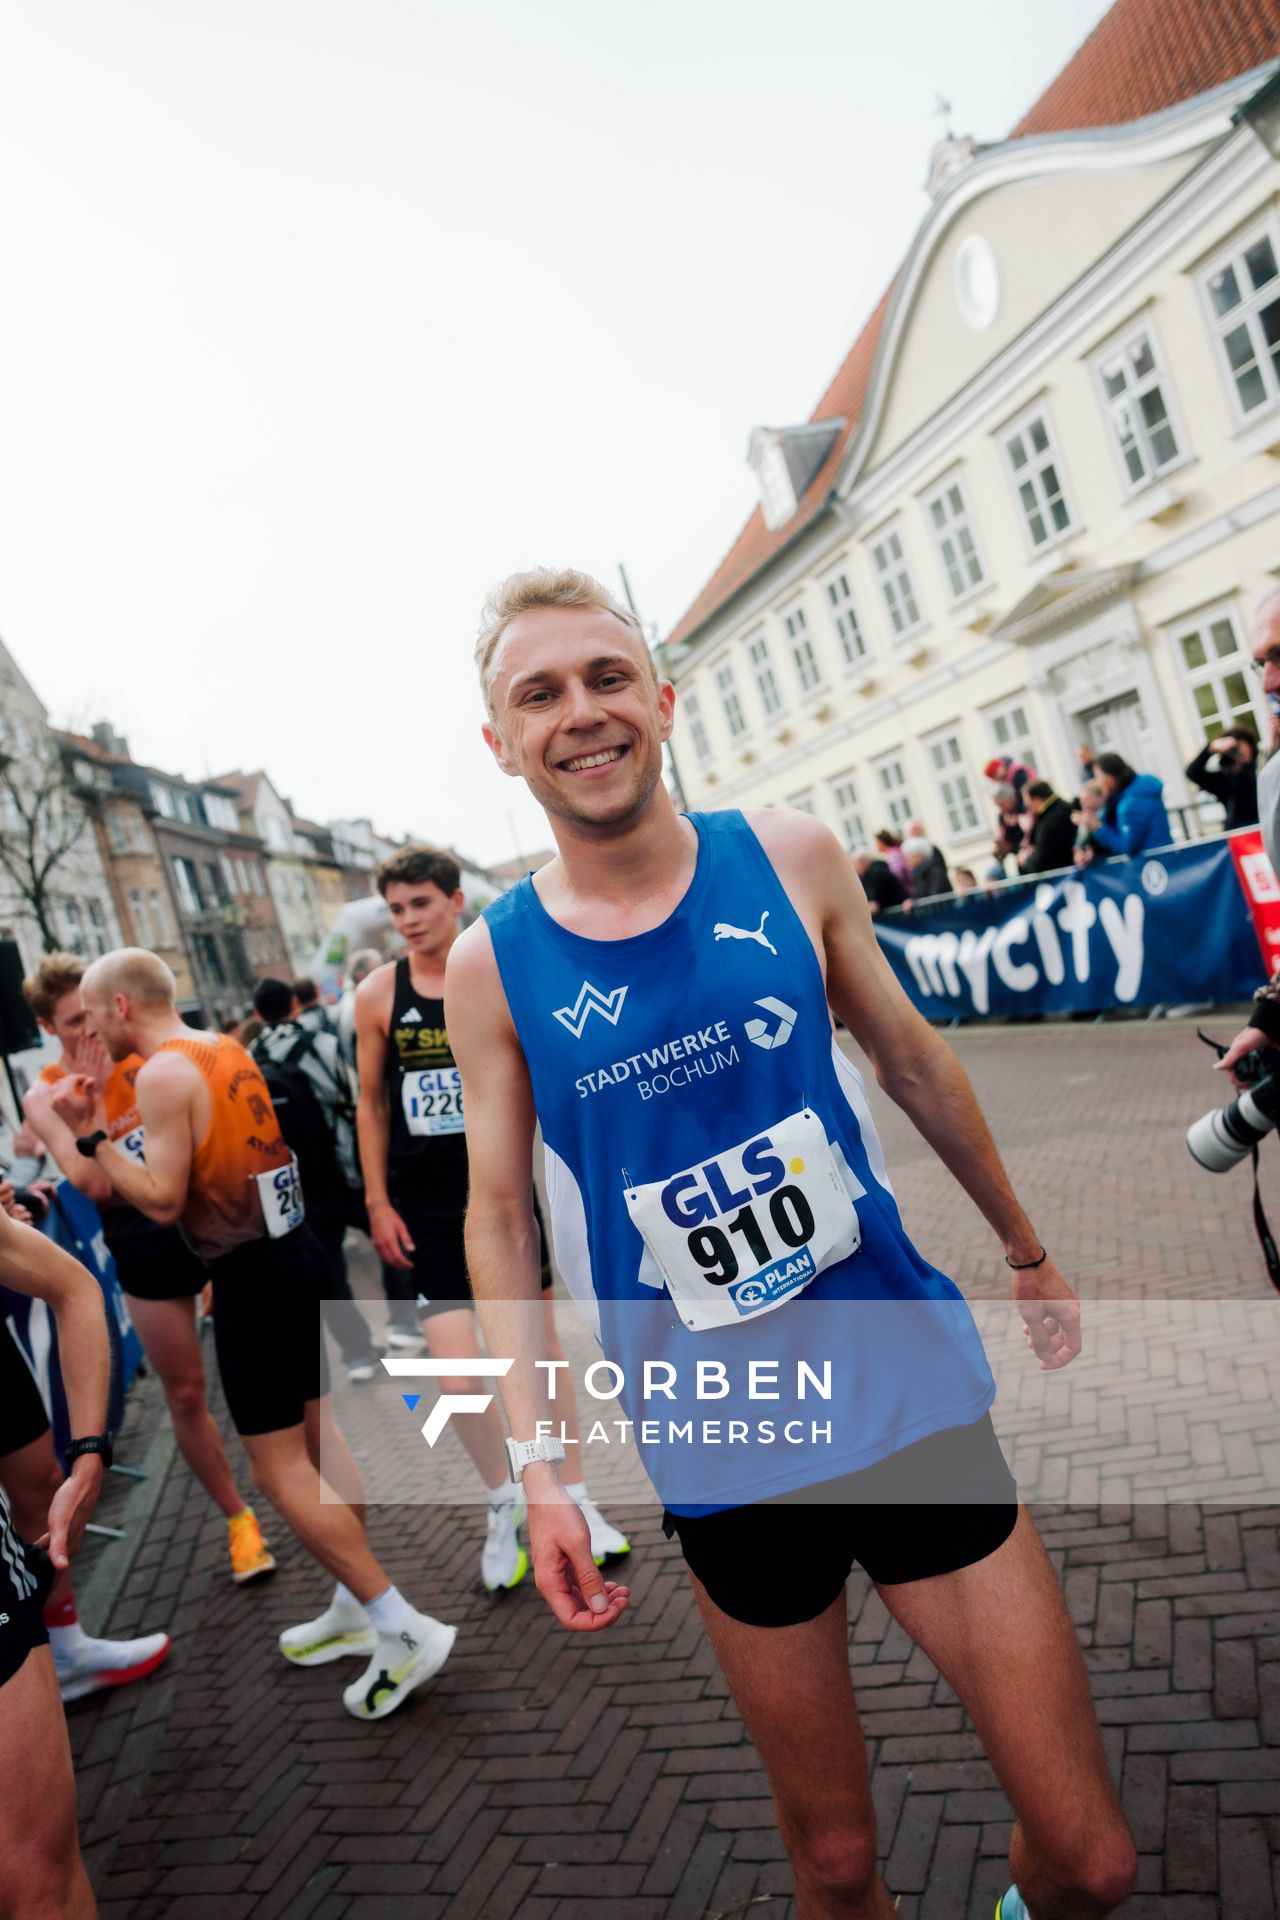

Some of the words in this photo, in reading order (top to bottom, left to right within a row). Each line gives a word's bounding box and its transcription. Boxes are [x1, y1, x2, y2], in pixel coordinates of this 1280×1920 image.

[904, 880, 1145, 1015] mycity
[575, 1020, 732, 1099] STADTWERKE
[636, 1044, 741, 1101] BOCHUM
[273, 1166, 298, 1191] GL
[687, 1184, 816, 1286] 910
[764, 1254, 812, 1289] PLAN
[771, 1269, 814, 1296] INTERNATIONAL
